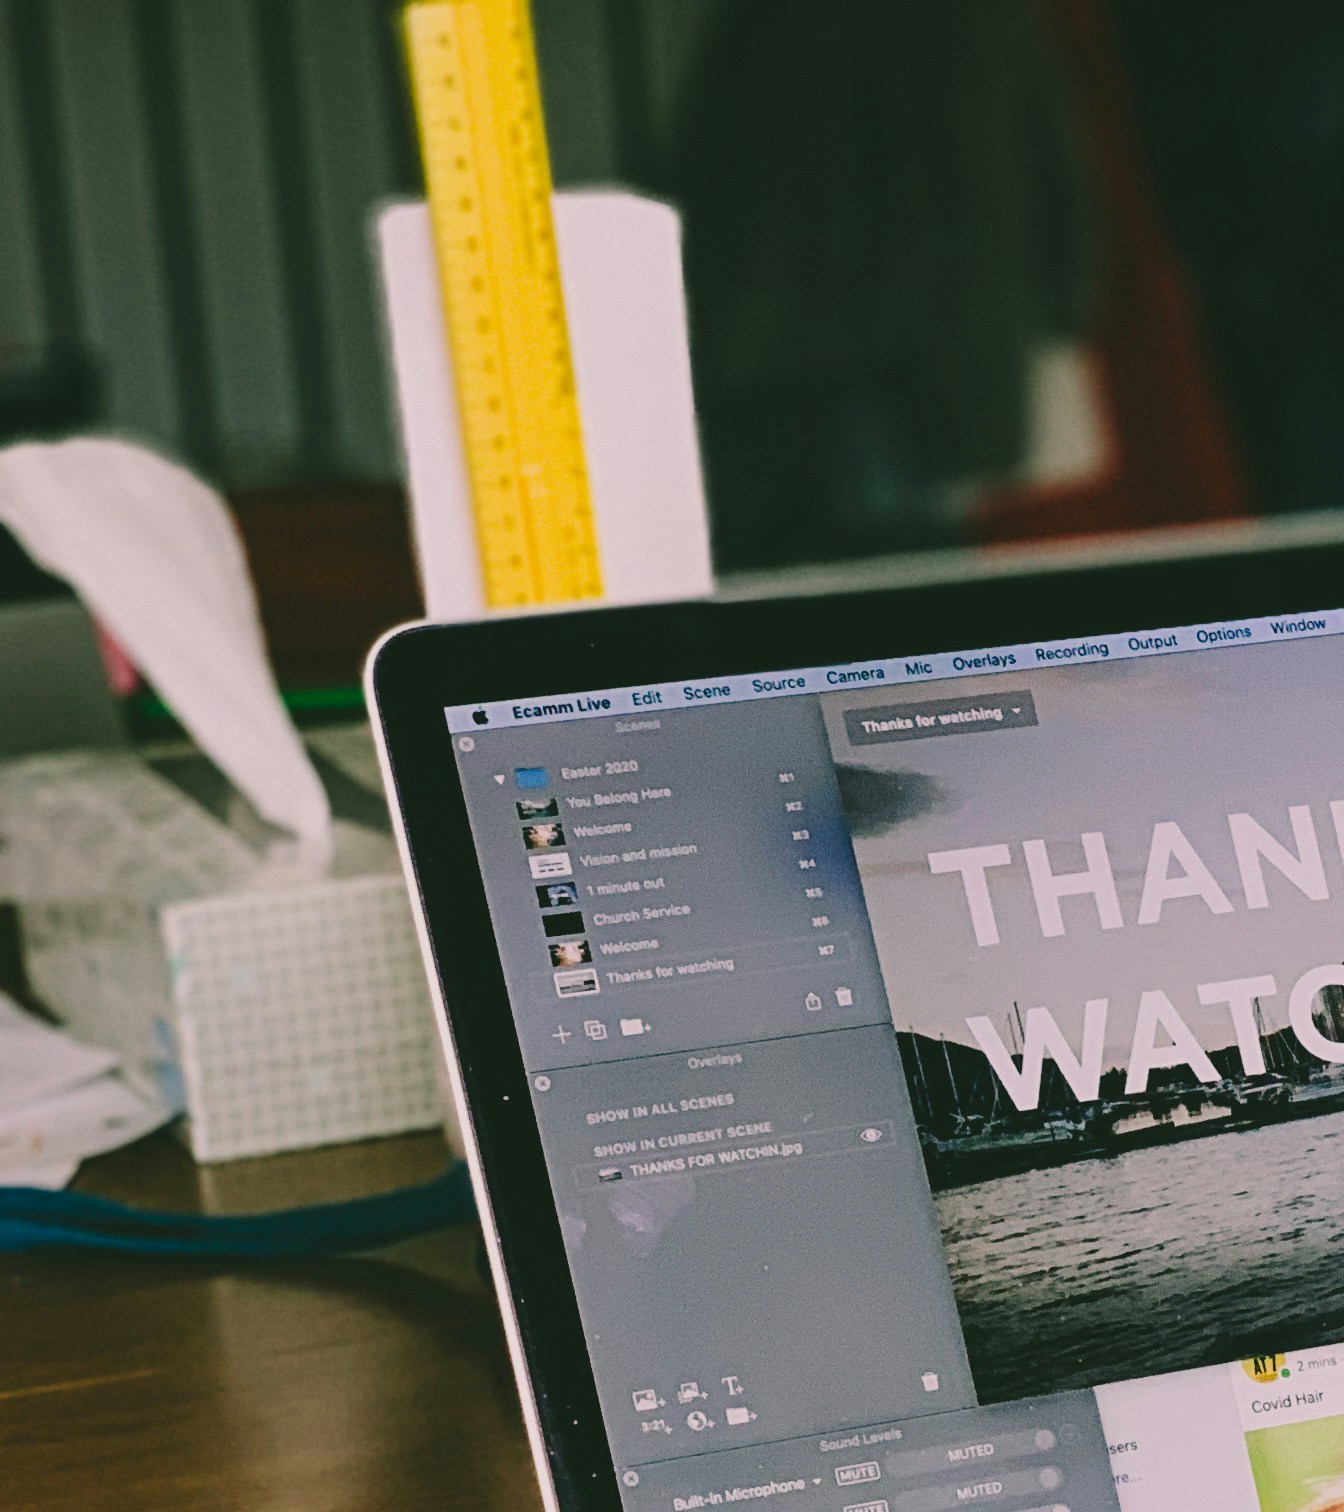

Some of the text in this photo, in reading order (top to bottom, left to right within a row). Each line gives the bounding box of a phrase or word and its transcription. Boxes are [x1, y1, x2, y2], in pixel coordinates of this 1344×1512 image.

[1270, 616, 1327, 634] Window
[1128, 634, 1178, 651] Output
[1196, 626, 1252, 646] Options
[1035, 641, 1110, 661] Recording
[905, 662, 933, 676] Mic
[953, 653, 1017, 671] Overlays
[752, 675, 806, 693] Source
[826, 667, 885, 685] Camera
[632, 691, 663, 706] Edit
[683, 685, 731, 700] Scene
[512, 697, 611, 719] Ecamm Live
[614, 719, 661, 733] Scenes
[861, 707, 1004, 734] Thanks for watching
[560, 760, 639, 780] Easter 2020
[566, 786, 672, 809] You Belong Here
[573, 821, 633, 838] Welcome
[579, 842, 698, 868] Vision and mission
[596, 880, 642, 895] minute
[643, 876, 666, 890] out
[593, 904, 691, 927] Church Service
[599, 938, 659, 954] Welcome
[606, 957, 735, 984] Thanks for watching
[687, 1053, 743, 1070] Overlays
[586, 1093, 735, 1125] SHOW IN ALL SCENES
[593, 1121, 772, 1158] SHOW IN CURRENT SCENE
[630, 1158, 686, 1177] THANKS
[688, 1154, 715, 1169] FOR
[1308, 1356, 1338, 1371] mins
[1252, 1389, 1324, 1414] Covid Hair
[820, 1428, 903, 1452] Sound Levels
[948, 1443, 995, 1462] MUTED
[839, 1466, 876, 1483] MUTE
[673, 1477, 806, 1512] Built-in Microphone
[957, 1481, 1002, 1500] MUTED
